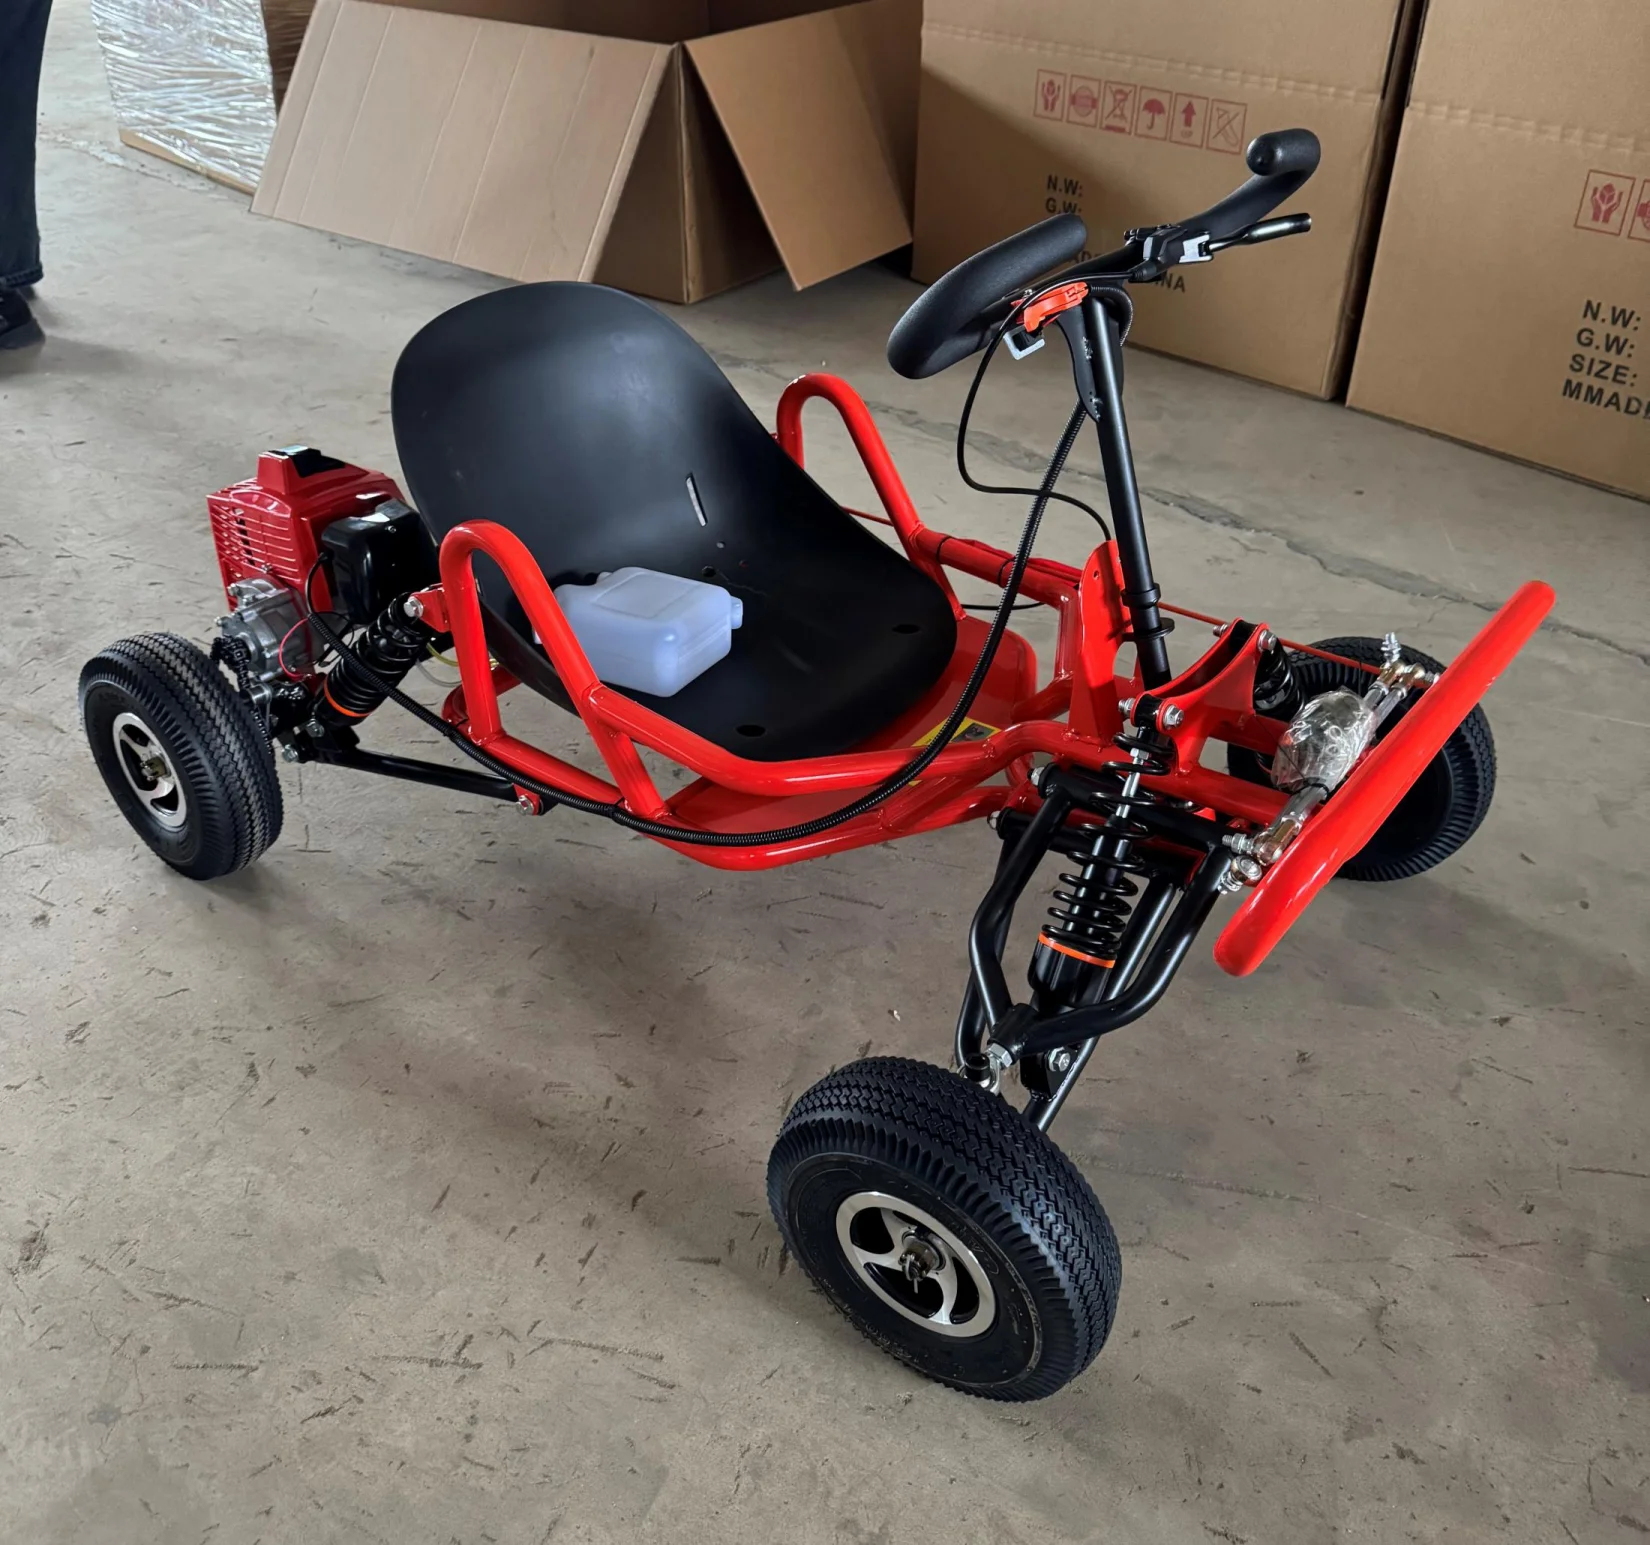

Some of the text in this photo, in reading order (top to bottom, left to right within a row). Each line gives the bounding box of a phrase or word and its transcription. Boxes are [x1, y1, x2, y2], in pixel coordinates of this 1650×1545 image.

[1047, 174, 1083, 197] N.W:
[1583, 300, 1641, 331] N.W:
[1576, 328, 1635, 358] G.W:
[1569, 353, 1637, 387] SIZE:
